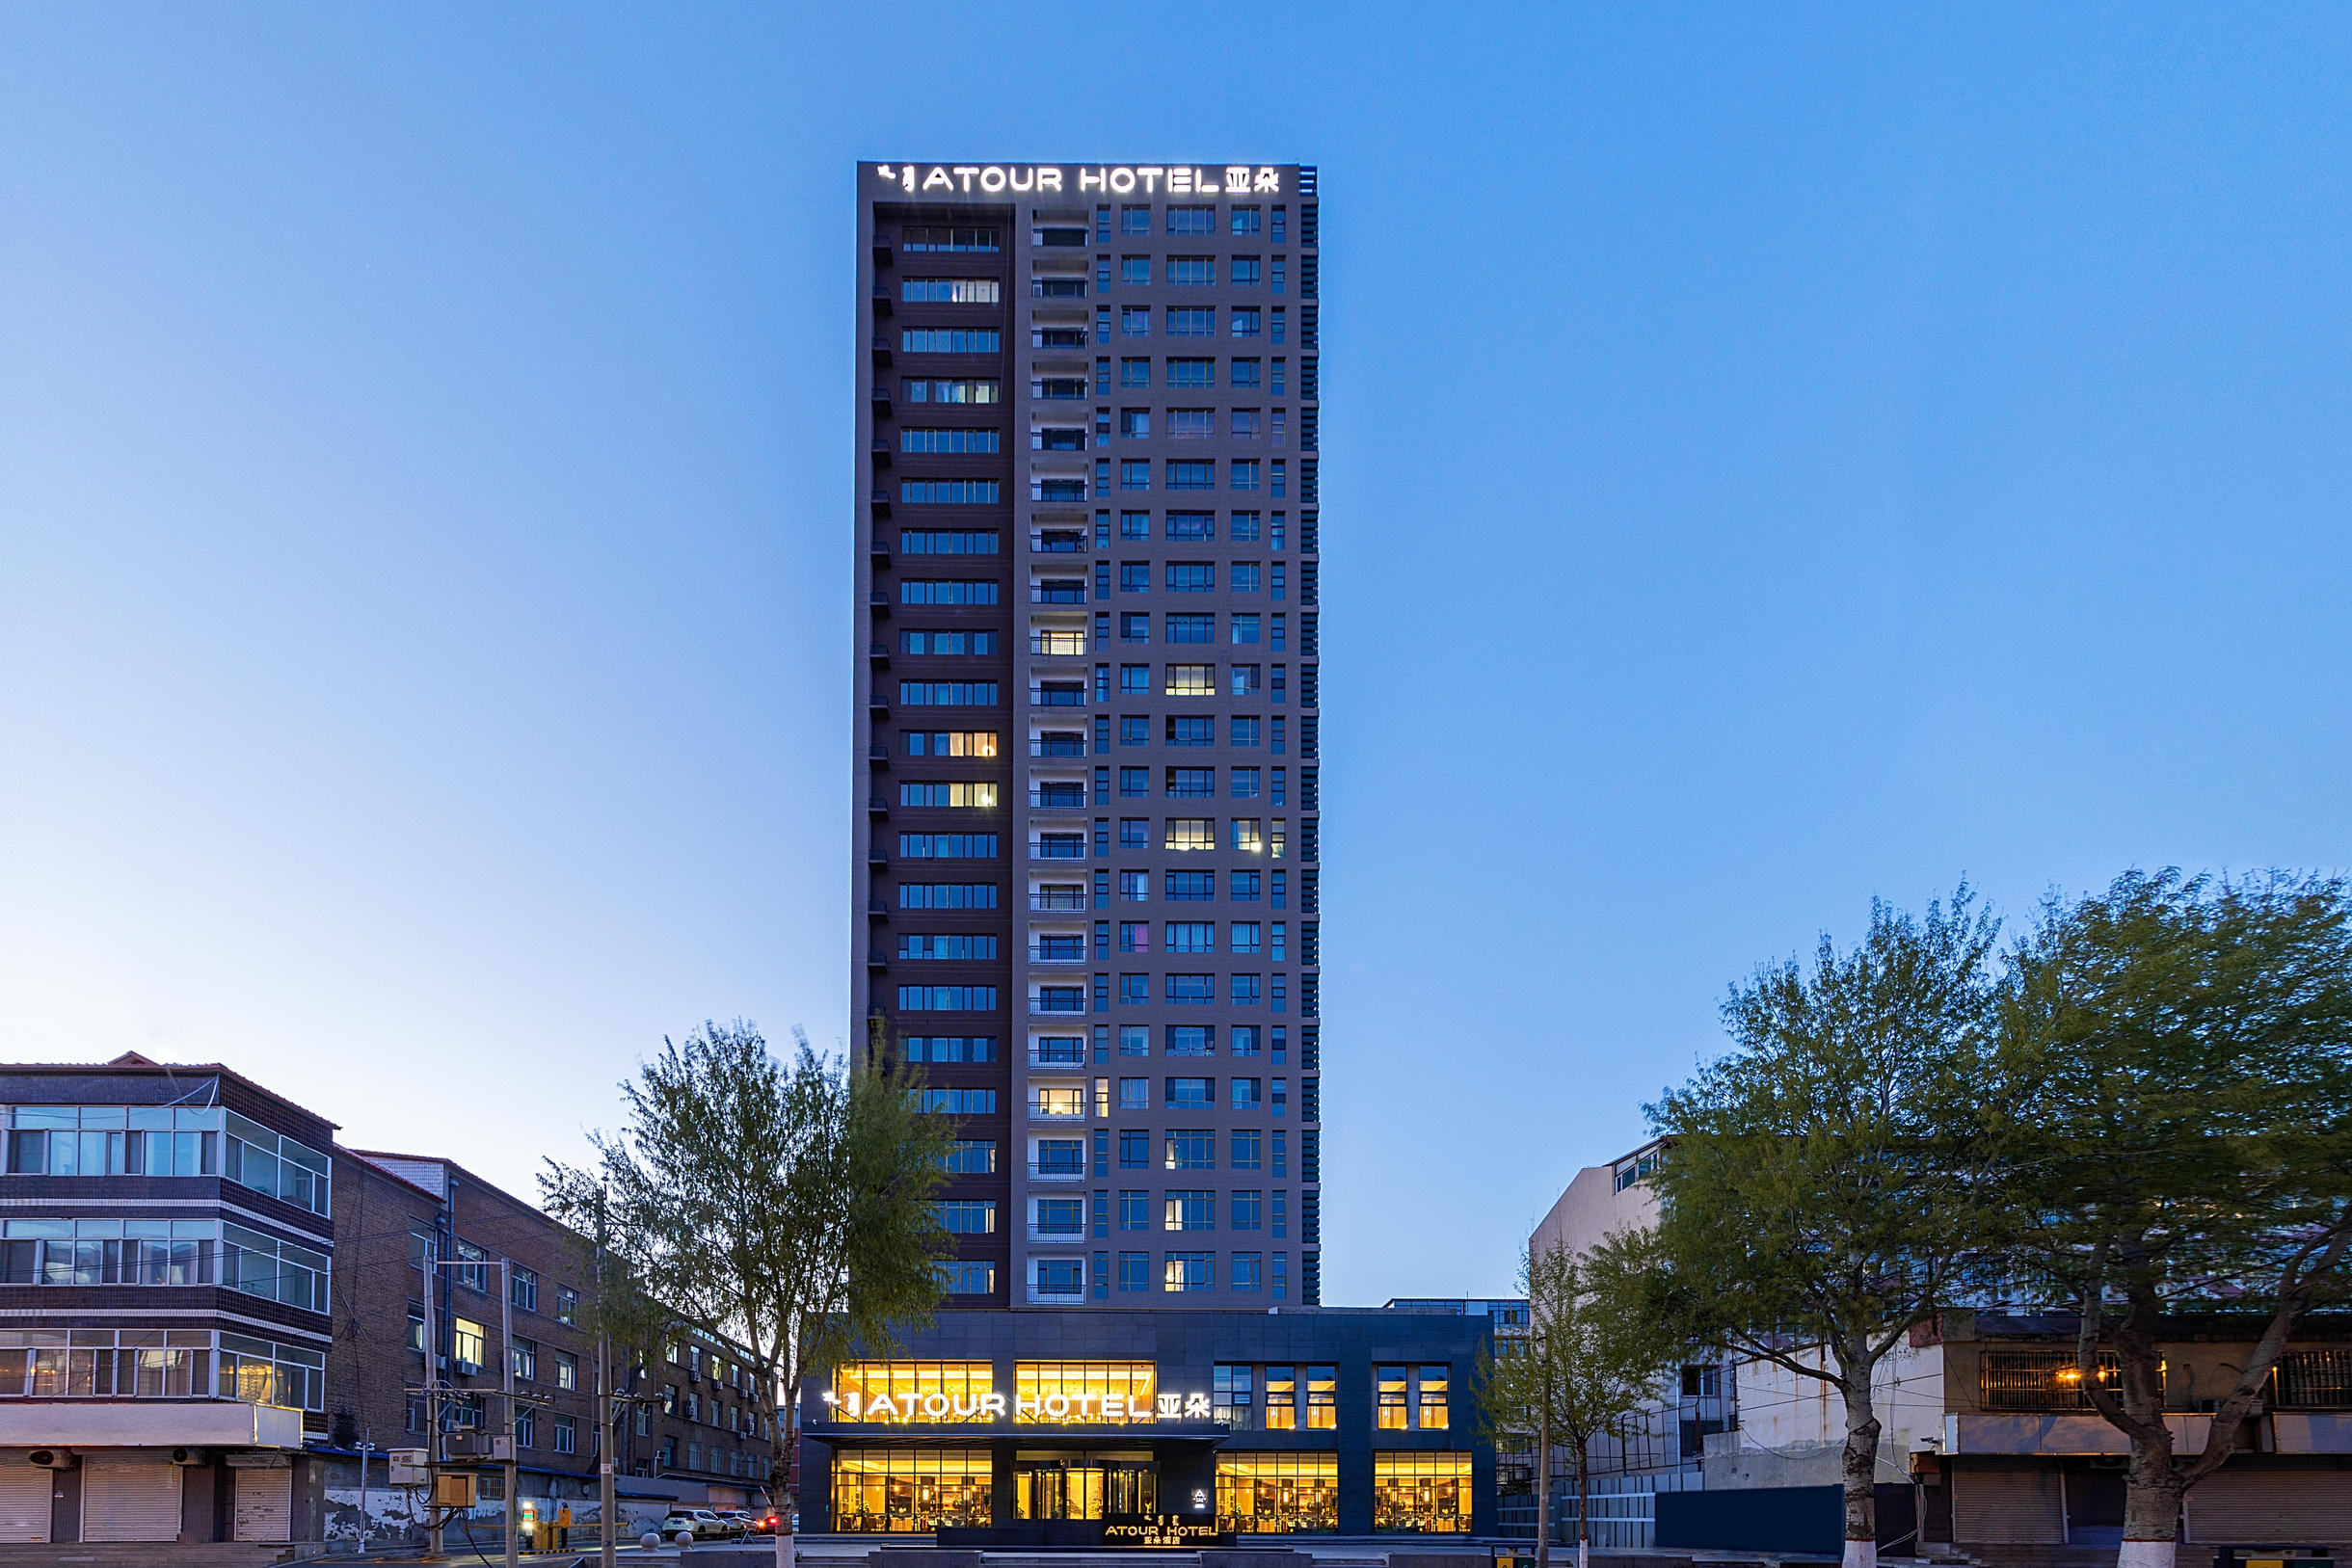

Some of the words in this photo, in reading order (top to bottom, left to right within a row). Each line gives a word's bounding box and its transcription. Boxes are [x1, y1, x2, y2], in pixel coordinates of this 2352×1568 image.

[922, 167, 1061, 192] ATOUR
[1080, 168, 1219, 192] HOTEL
[1225, 167, 1279, 193] 亚朵
[867, 1393, 1005, 1417] ATOUR
[1015, 1393, 1152, 1418] HOTEL
[1157, 1393, 1211, 1419] 亚朵
[1105, 1526, 1159, 1536] ATOUR
[1166, 1526, 1218, 1536] HOTEL
[1143, 1536, 1181, 1545] 亚朵酒店
